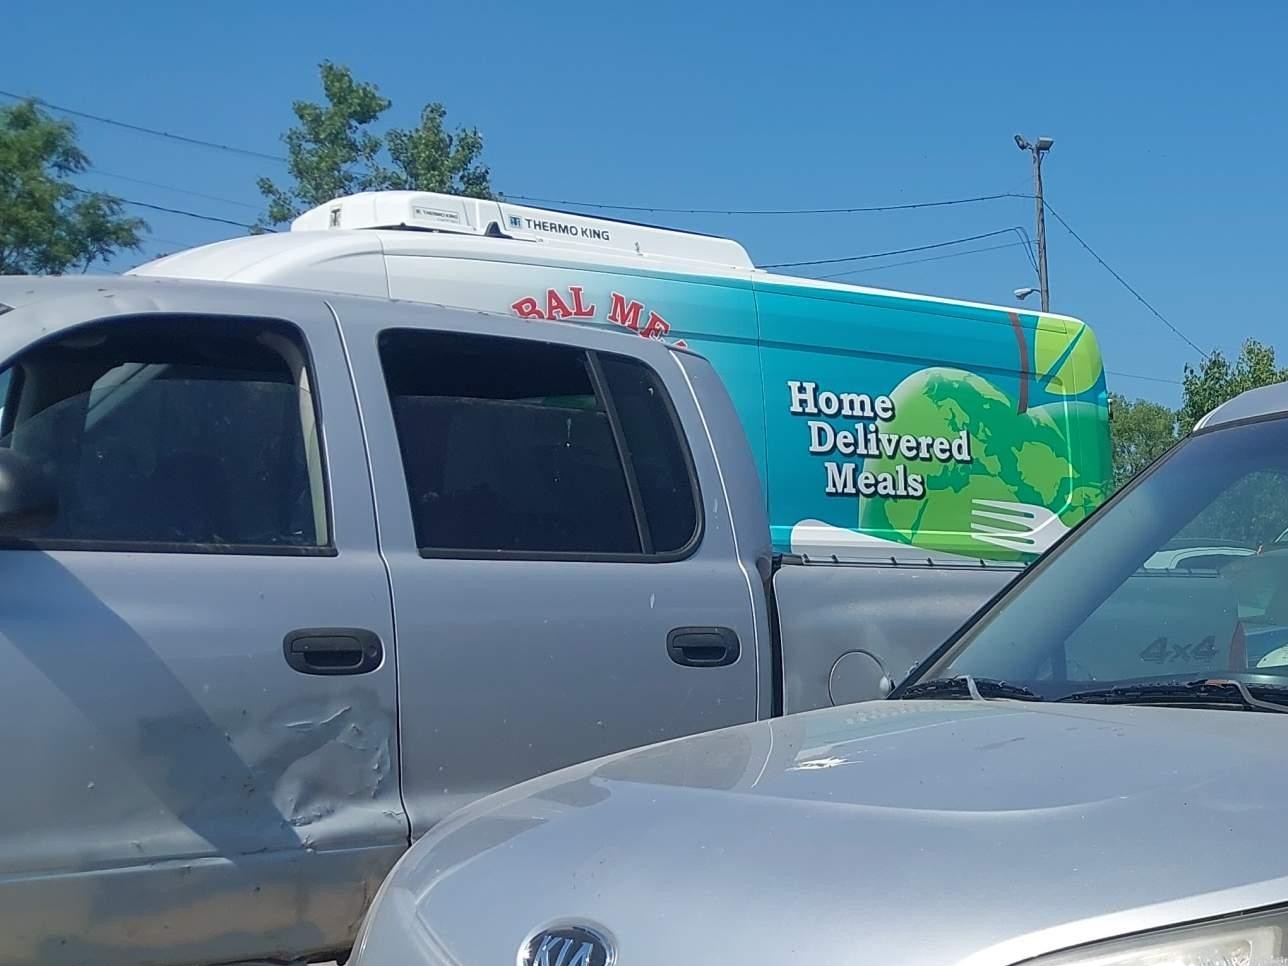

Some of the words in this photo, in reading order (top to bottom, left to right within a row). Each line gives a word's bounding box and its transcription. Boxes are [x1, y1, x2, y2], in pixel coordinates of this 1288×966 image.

[525, 218, 578, 236] THERMO
[580, 226, 610, 241] KING
[787, 380, 895, 421] Home
[807, 419, 974, 464] Delivered
[824, 461, 927, 500] Meals
